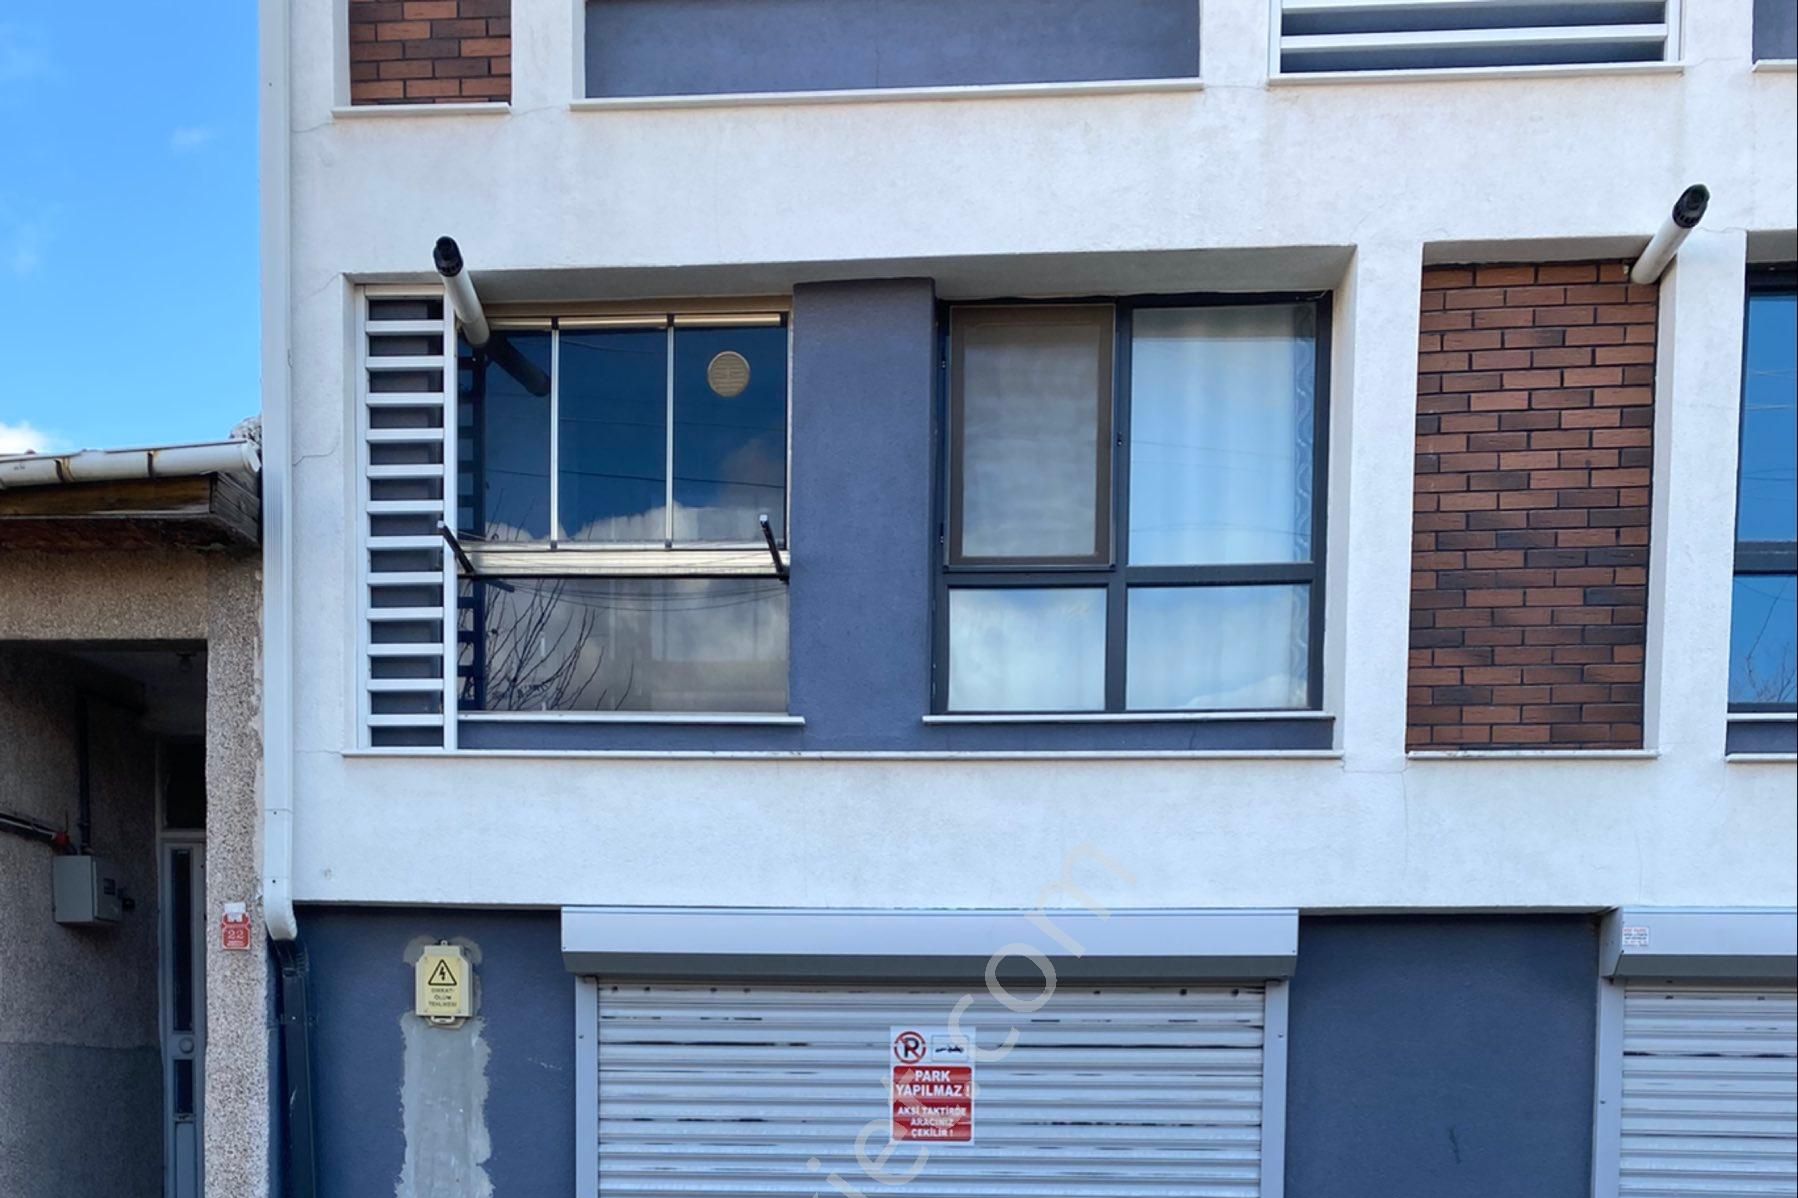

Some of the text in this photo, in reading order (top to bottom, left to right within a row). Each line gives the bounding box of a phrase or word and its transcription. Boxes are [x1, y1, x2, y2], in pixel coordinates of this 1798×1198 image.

[228, 929, 244, 940] 22
[915, 1070, 950, 1082] PARK
[895, 1084, 962, 1097] YAPILMAZ
[910, 1118, 954, 1127] ARACINIZ
